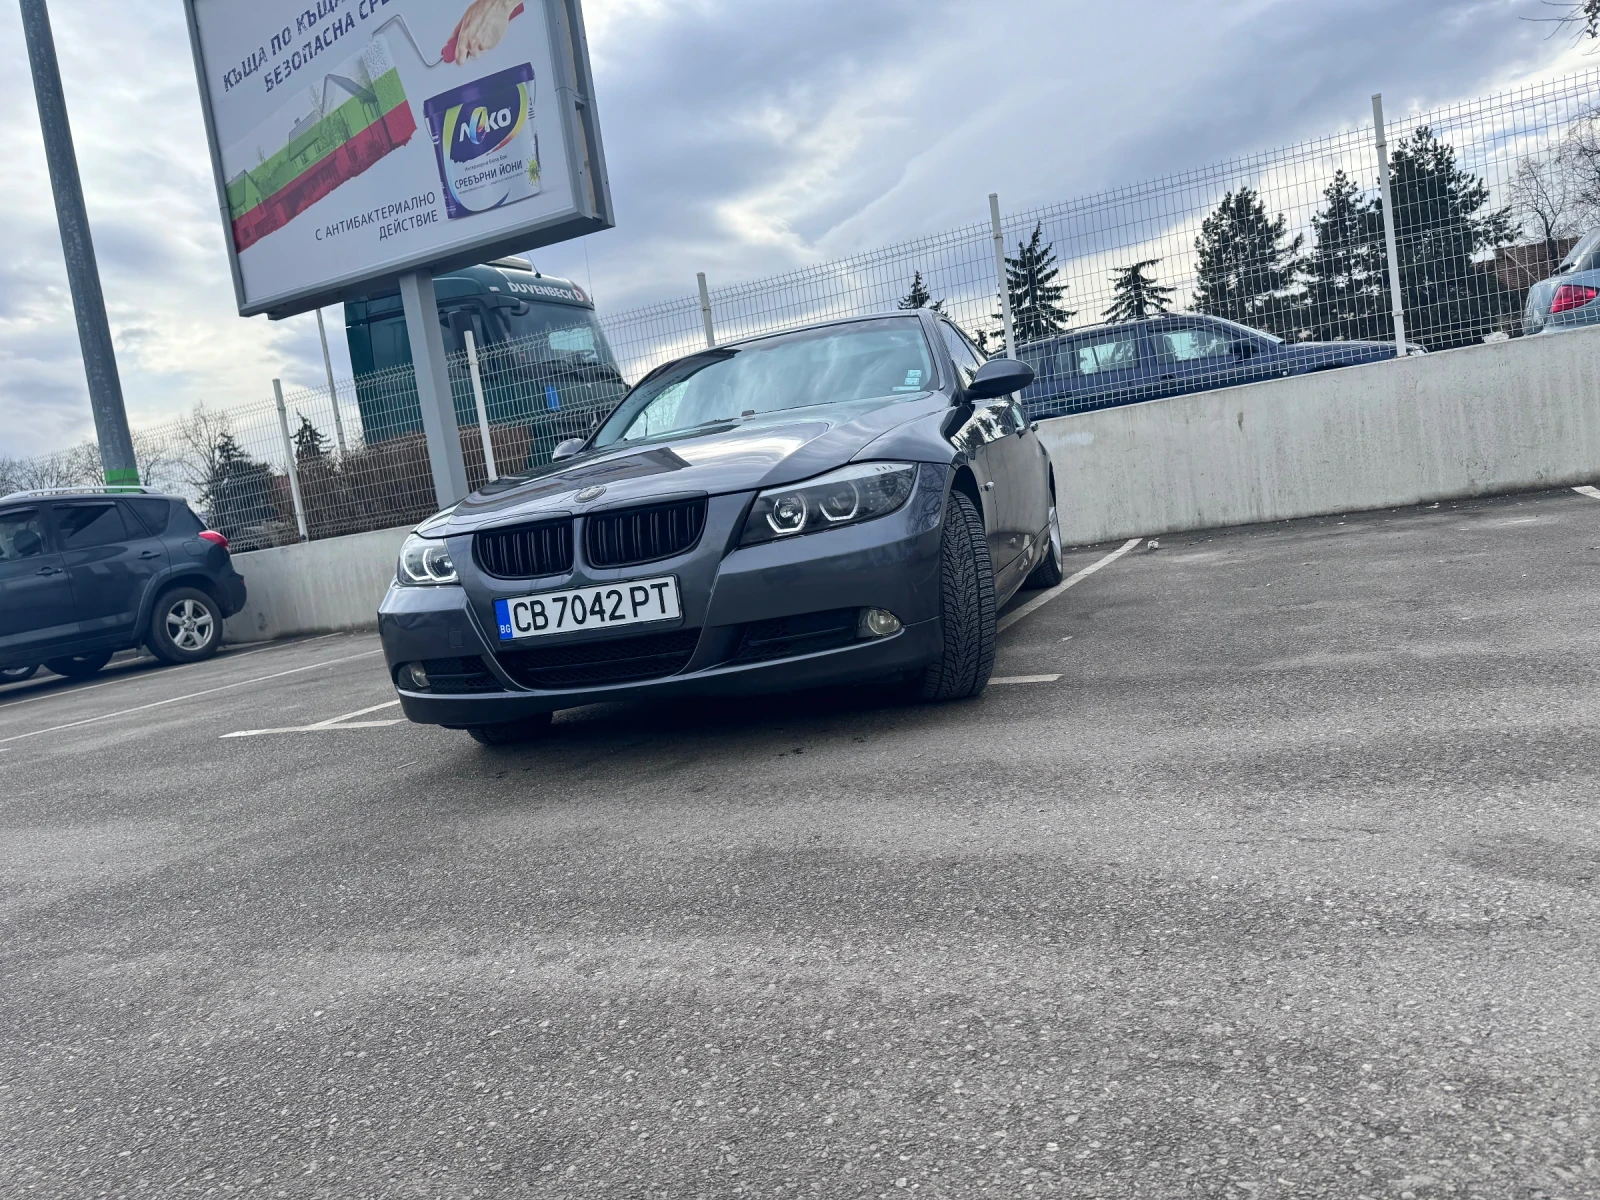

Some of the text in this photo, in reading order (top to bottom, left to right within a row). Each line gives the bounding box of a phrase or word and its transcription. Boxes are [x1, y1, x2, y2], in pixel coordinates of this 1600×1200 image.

[223, 46, 268, 92] КЪЩА
[270, 26, 292, 56] ПО
[264, 0, 390, 93] БЕЗОПАСНА СР
[454, 168, 497, 190] СРЕБЪРНИ
[499, 159, 523, 177] ЙОНИ
[315, 191, 436, 241] С АНТИБАКТЕРИАЛНО
[379, 209, 439, 241] ДЕЙСТВИЕ
[507, 281, 575, 301] DUVENBECK
[499, 625, 512, 634] BG
